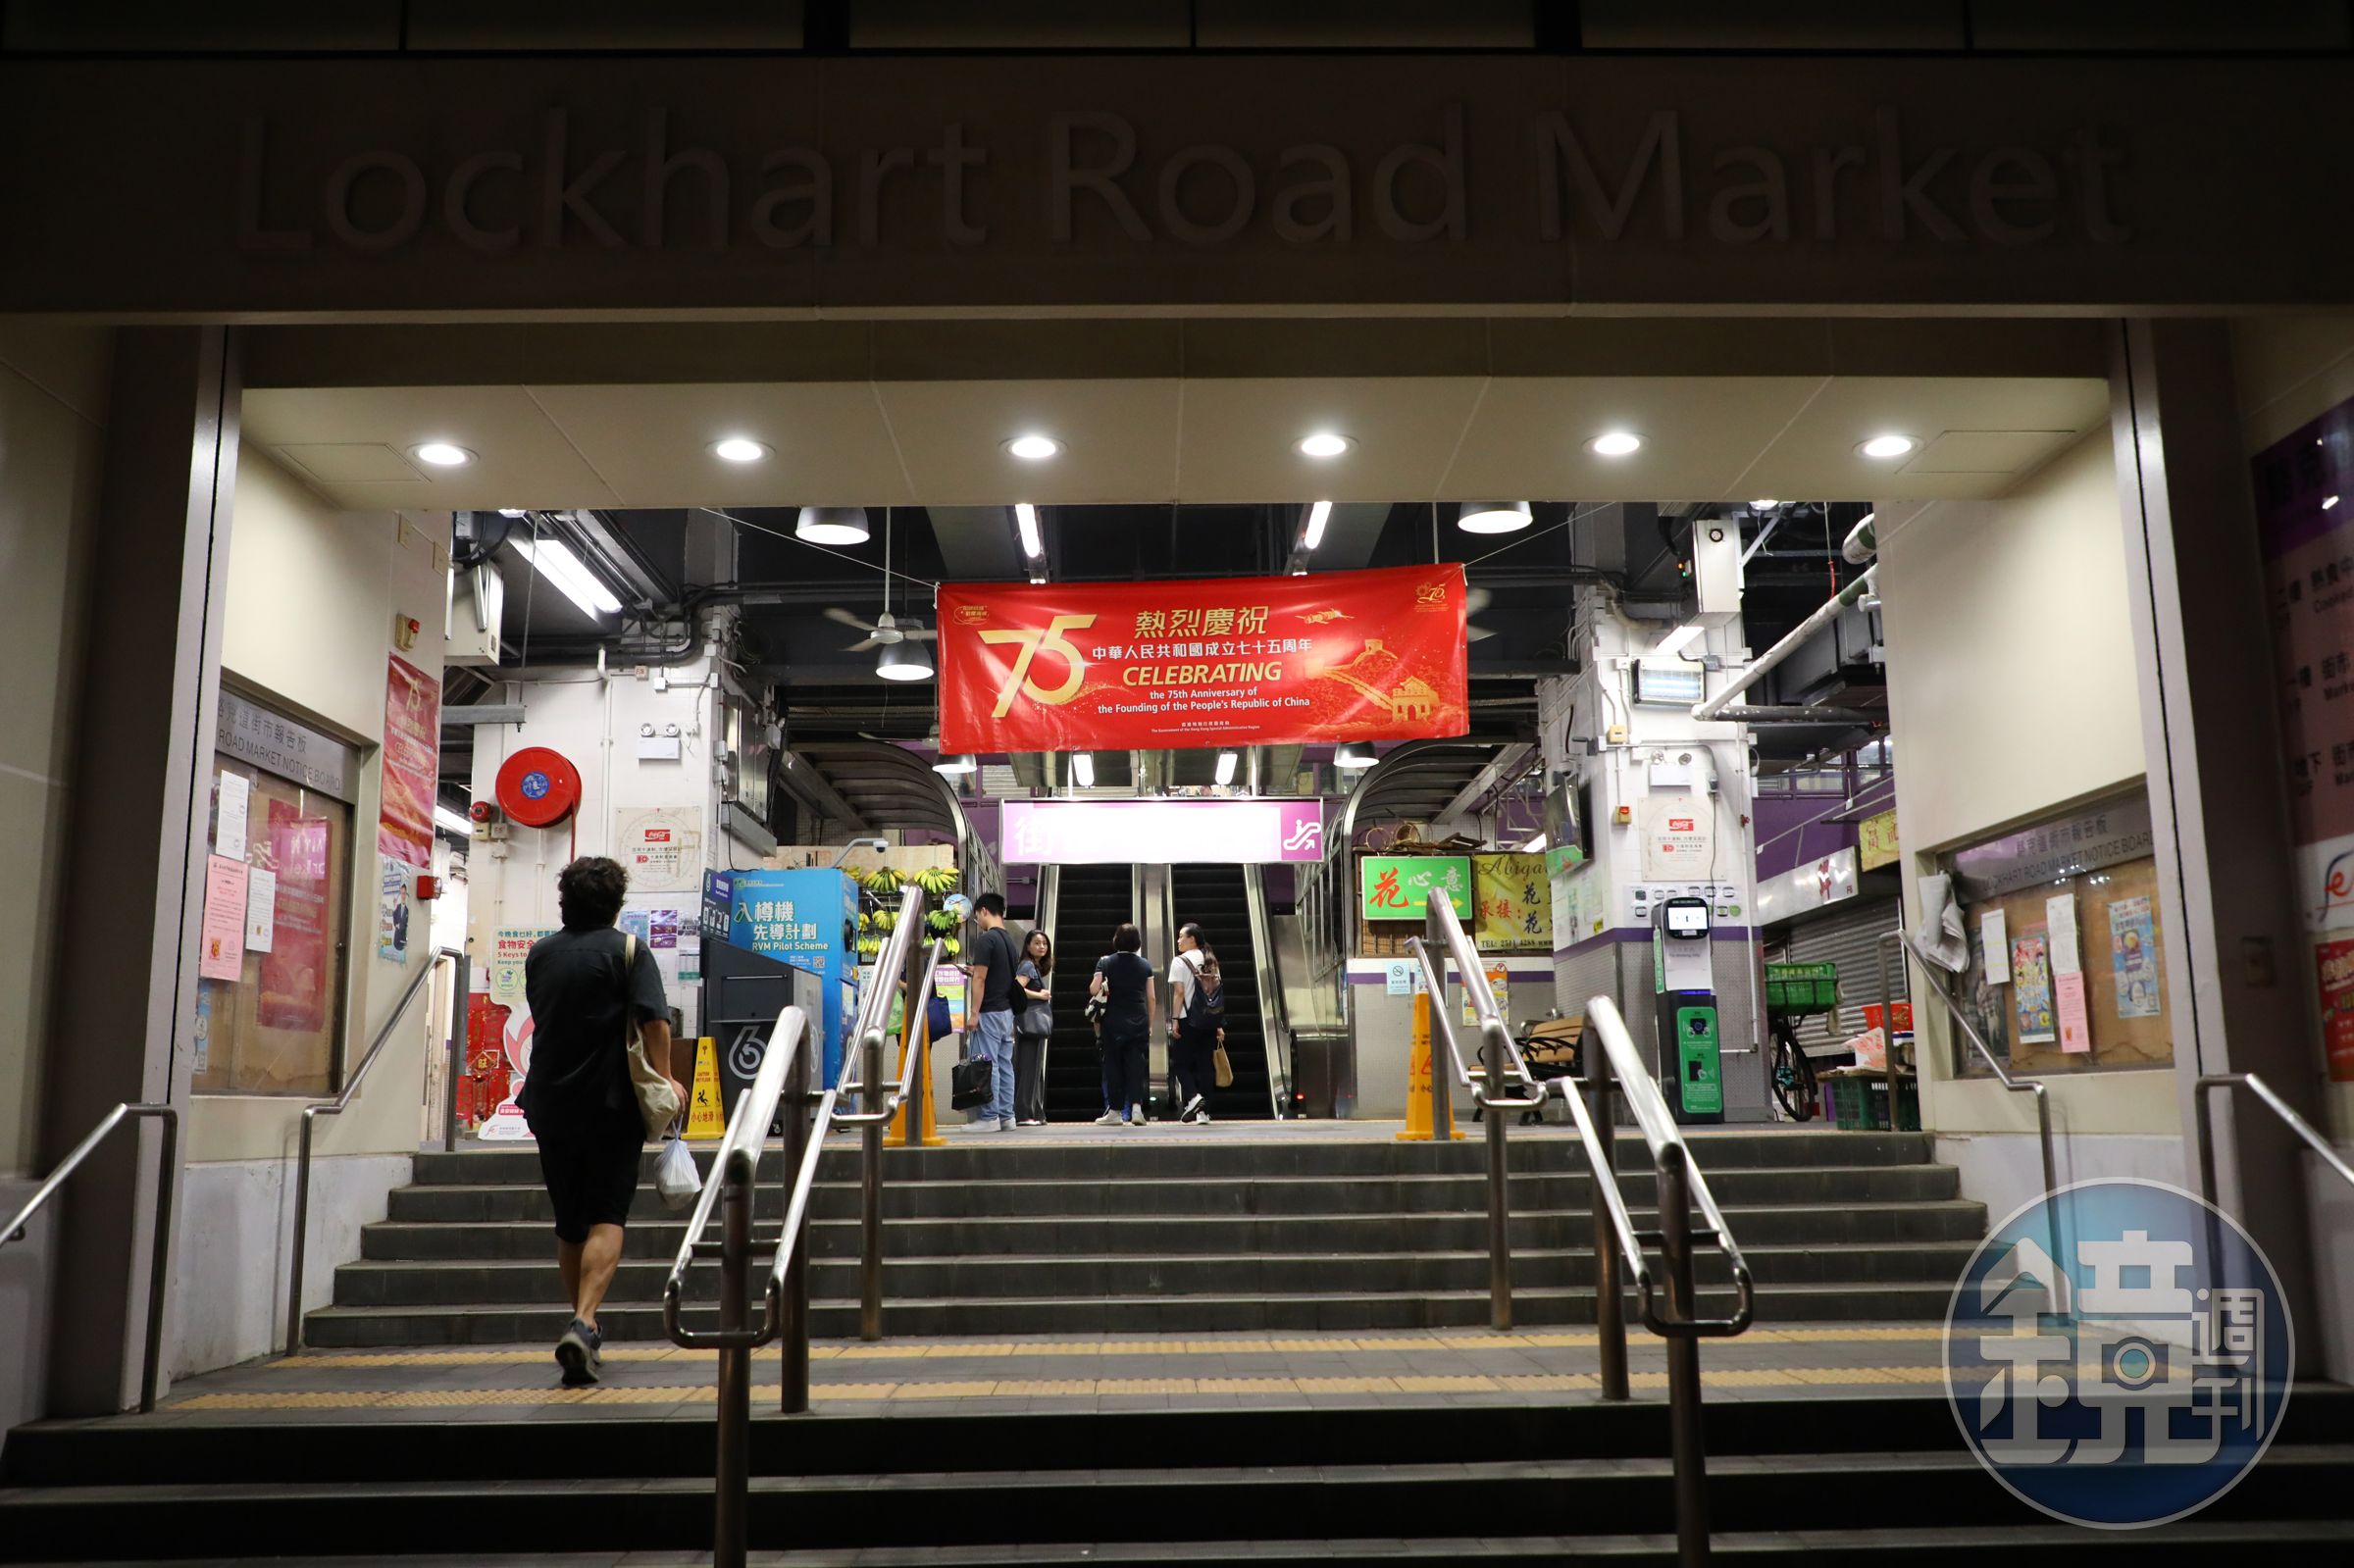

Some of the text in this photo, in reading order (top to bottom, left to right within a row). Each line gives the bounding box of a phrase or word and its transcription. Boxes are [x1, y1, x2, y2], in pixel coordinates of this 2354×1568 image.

[237, 101, 2135, 253] Lockhart Road Market
[1134, 605, 1269, 639] 熱烈慶祝
[1092, 637, 1313, 661] 中華人民共和國成立七十五周年
[977, 613, 1099, 719] 75
[1122, 660, 1283, 687] CELEBRATING
[1150, 686, 1258, 700] the 75th Anniversary of
[1098, 696, 1310, 715] the Founding of the People's Republic of China
[218, 729, 245, 752] ROAD
[246, 739, 281, 768] MARKET
[282, 755, 313, 781] NOTICE
[1369, 867, 1409, 909] 花
[734, 900, 794, 924] 入樽機
[753, 923, 817, 941] 先導計劃
[752, 941, 829, 951] RVM Pilot Scheme
[691, 1110, 714, 1123] 小心地滑
